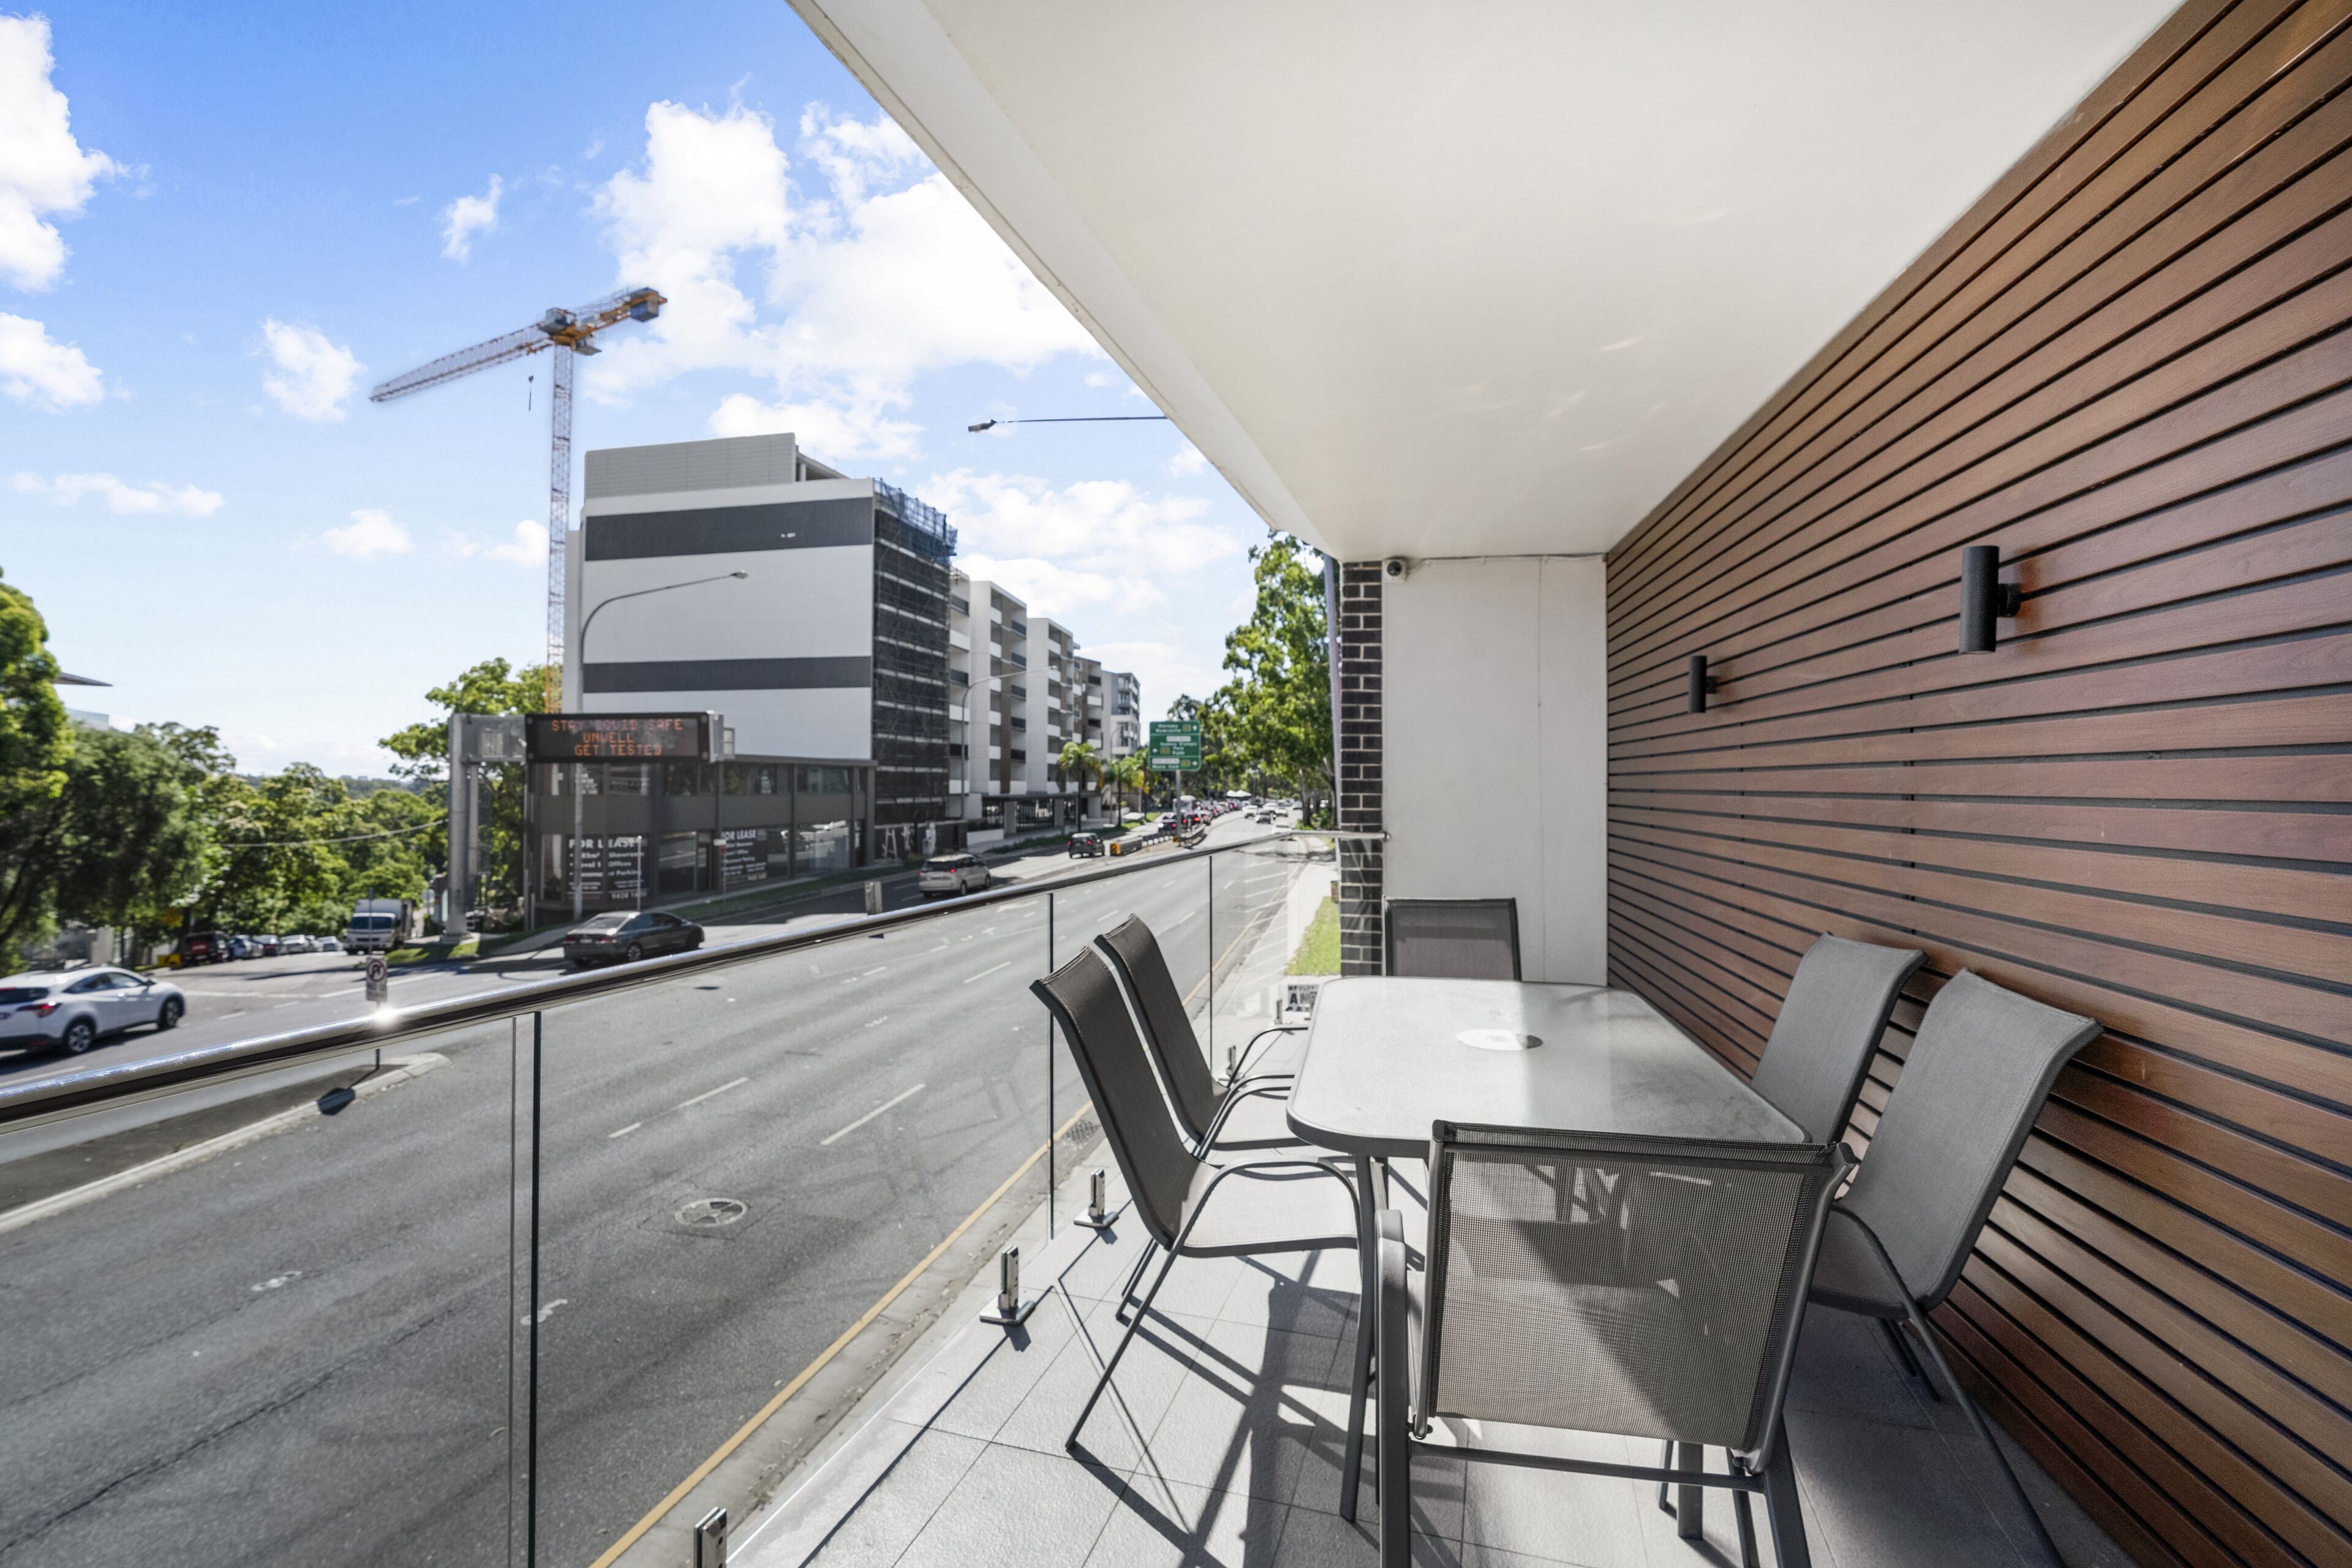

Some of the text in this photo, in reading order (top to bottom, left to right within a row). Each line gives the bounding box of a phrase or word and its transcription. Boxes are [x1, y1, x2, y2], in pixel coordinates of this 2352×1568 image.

[551, 720, 584, 731] STAY
[647, 718, 683, 731] SAFE
[583, 732, 634, 744] UNWELL
[575, 744, 662, 755] GET TESTED
